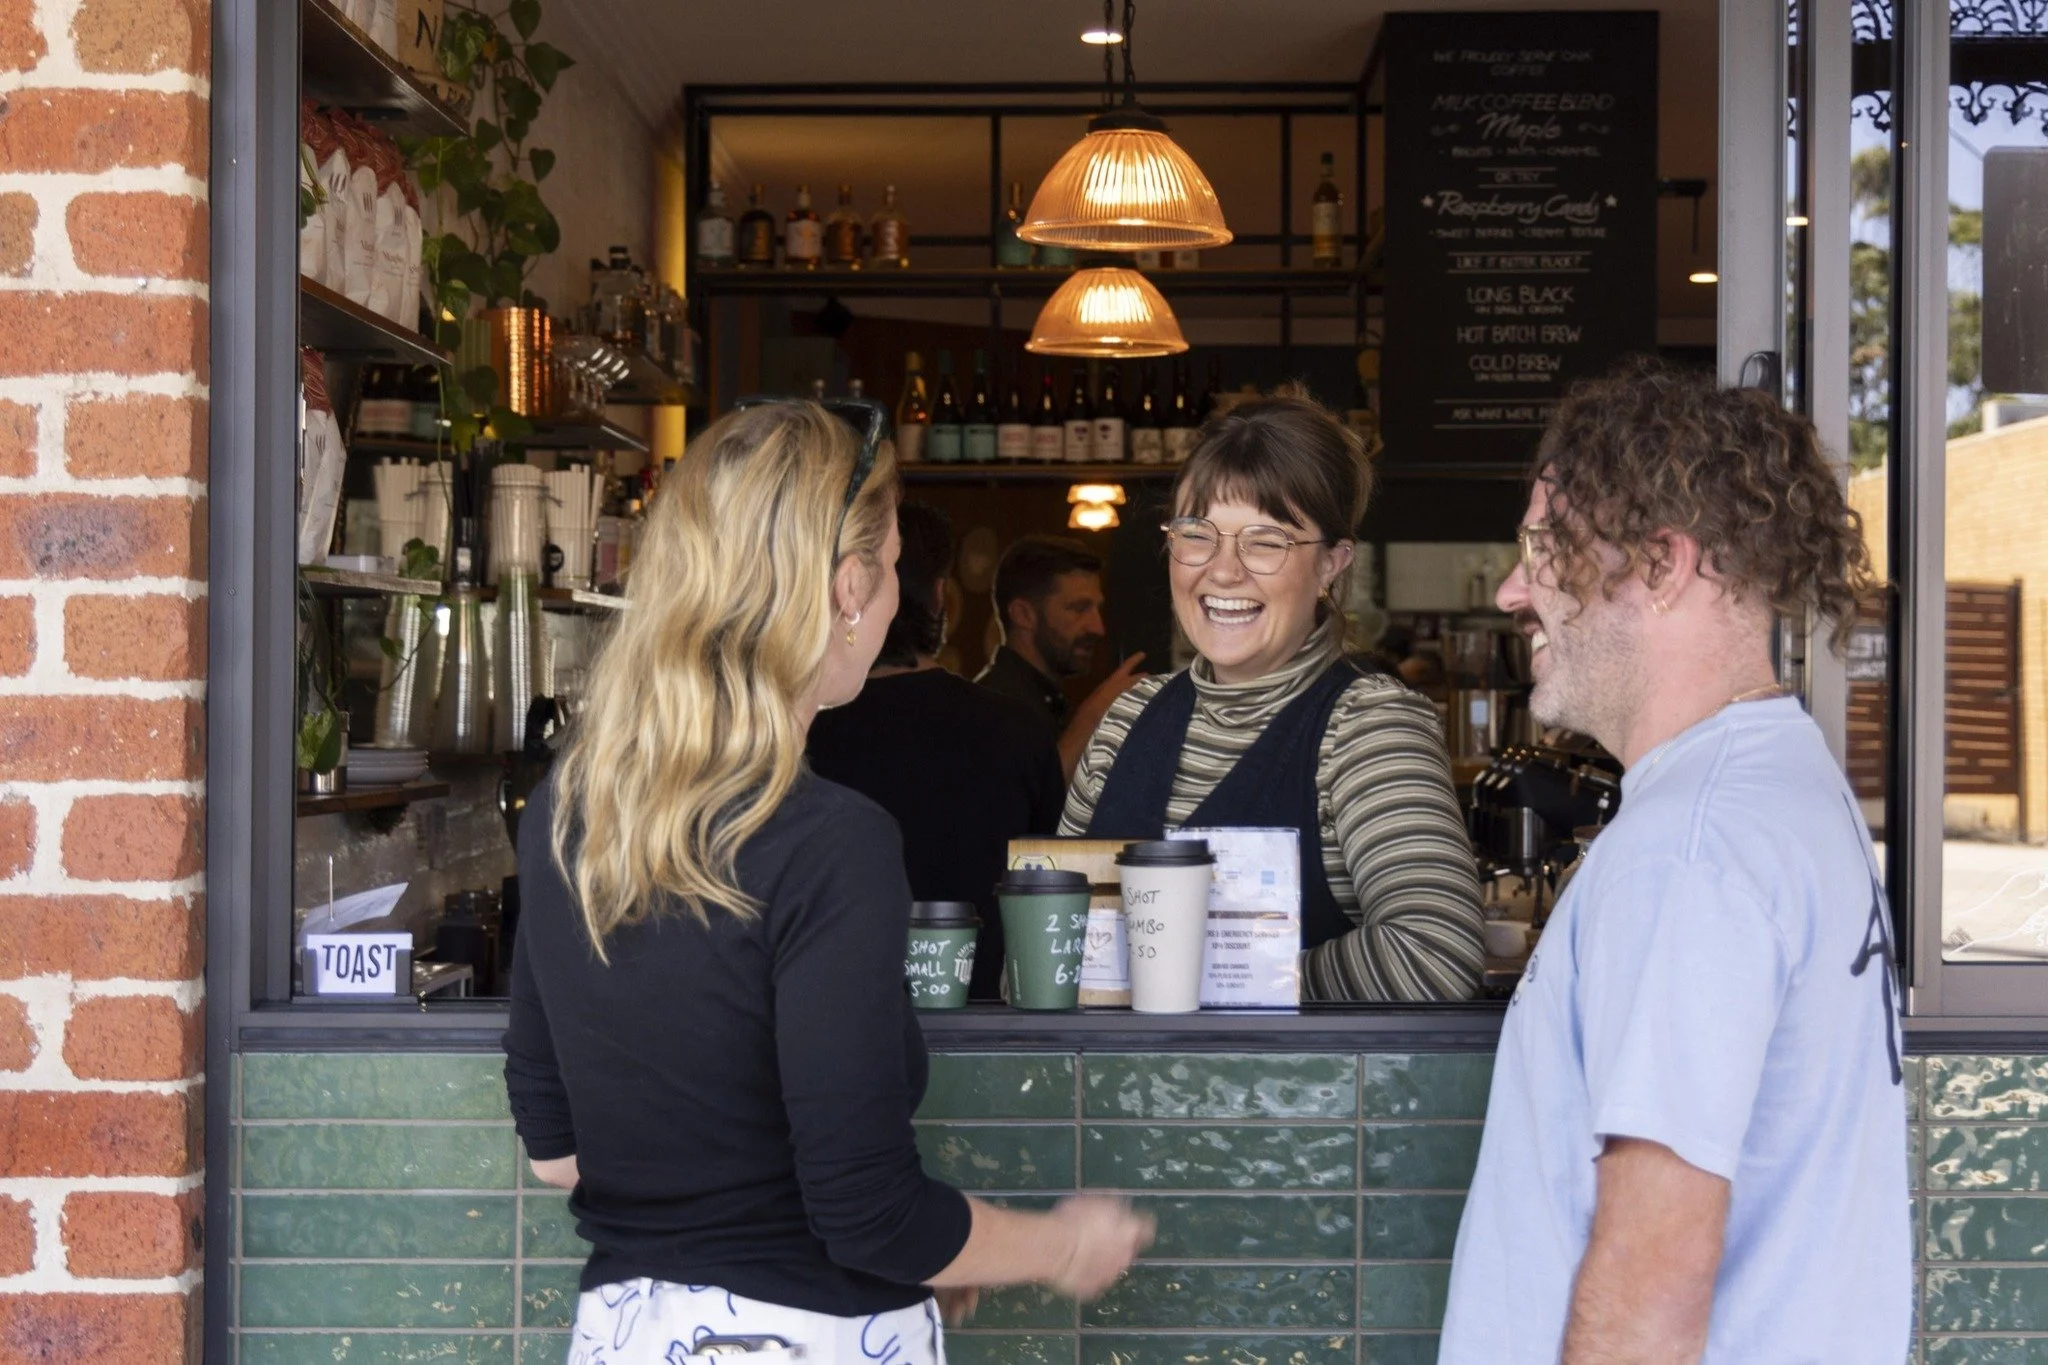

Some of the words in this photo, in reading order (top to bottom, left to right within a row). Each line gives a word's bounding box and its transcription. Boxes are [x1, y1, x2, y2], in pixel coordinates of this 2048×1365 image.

[416, 8, 438, 52] N
[1430, 93, 1480, 111] MILK
[1480, 93, 1558, 111] COFFEE
[1558, 92, 1616, 111] BLEND
[1476, 111, 1562, 151] Maple
[1437, 189, 1541, 224] Raspberry
[1543, 191, 1600, 224] Candy
[1466, 285, 1513, 304] LONG
[1519, 284, 1575, 304] BLACK
[1457, 325, 1487, 343] HOT
[1491, 325, 1537, 344] BATCH
[1540, 324, 1583, 344] BREW
[1468, 353, 1515, 371] COLD
[1516, 353, 1562, 372] BREW
[1127, 886, 1161, 906] SHOT
[1045, 913, 1061, 932] 2
[910, 939, 952, 957] SHOT
[322, 944, 397, 983] TOAST
[904, 959, 947, 978] SMALL
